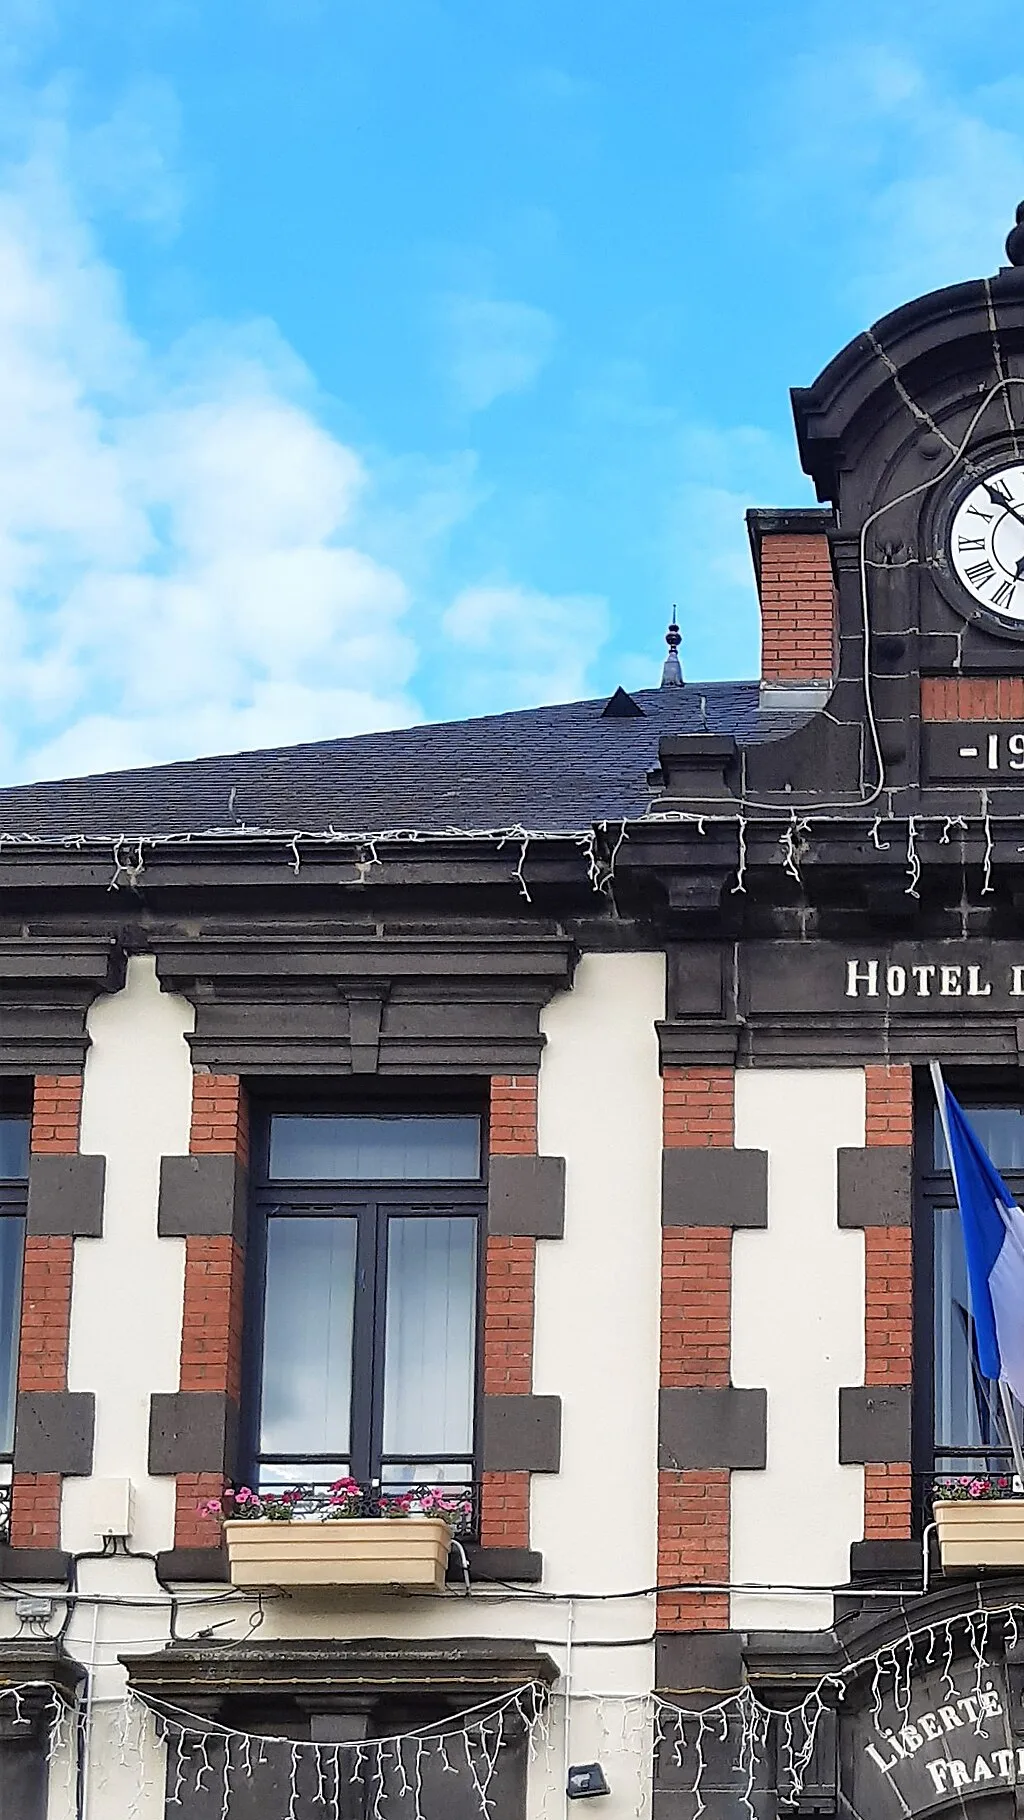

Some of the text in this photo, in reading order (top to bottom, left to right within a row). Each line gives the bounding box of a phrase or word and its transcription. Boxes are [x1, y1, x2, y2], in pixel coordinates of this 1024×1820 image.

[966, 505, 994, 524] X
[958, 535, 985, 553] IX
[964, 559, 997, 590] VIII
[989, 580, 1017, 609] VII
[846, 959, 992, 997] HOTEL
